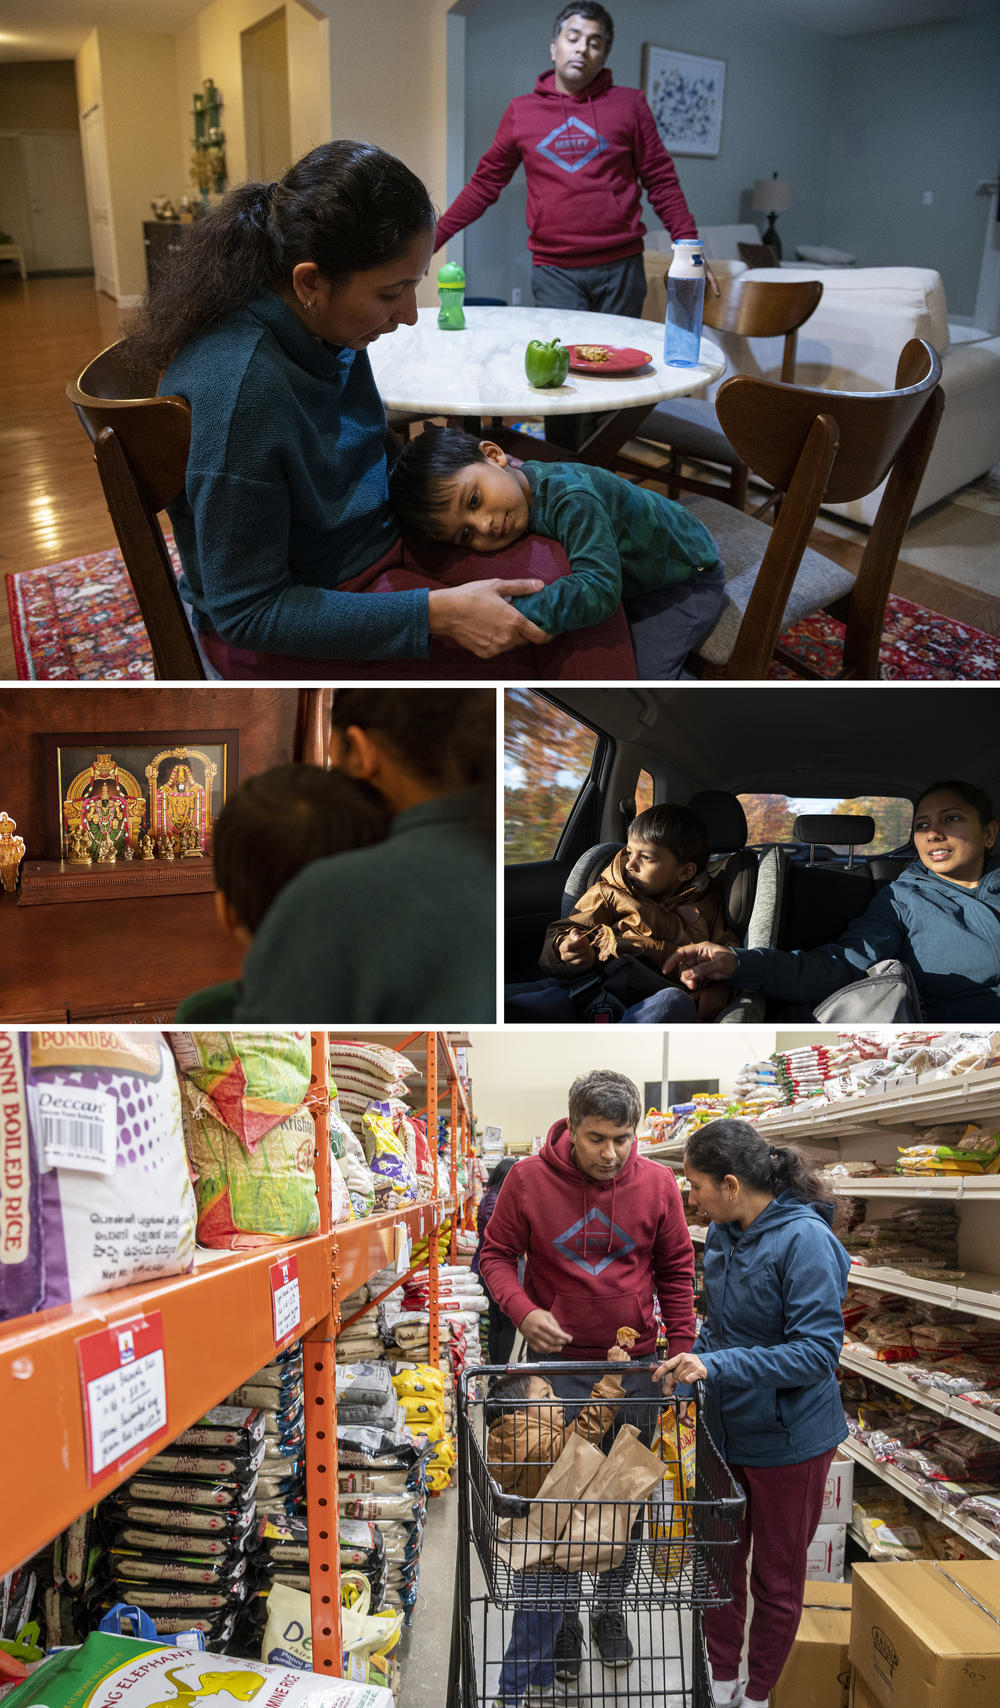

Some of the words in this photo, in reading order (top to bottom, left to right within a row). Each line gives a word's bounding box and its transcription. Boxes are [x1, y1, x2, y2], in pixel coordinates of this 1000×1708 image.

[0, 1032, 18, 1095] ONNI
[41, 1032, 94, 1048] PONNI
[39, 1092, 102, 1113] Deccan
[3, 1103, 23, 1190] BOILED
[5, 1196, 23, 1252] RICE
[115, 1649, 194, 1689] ELEPHANT
